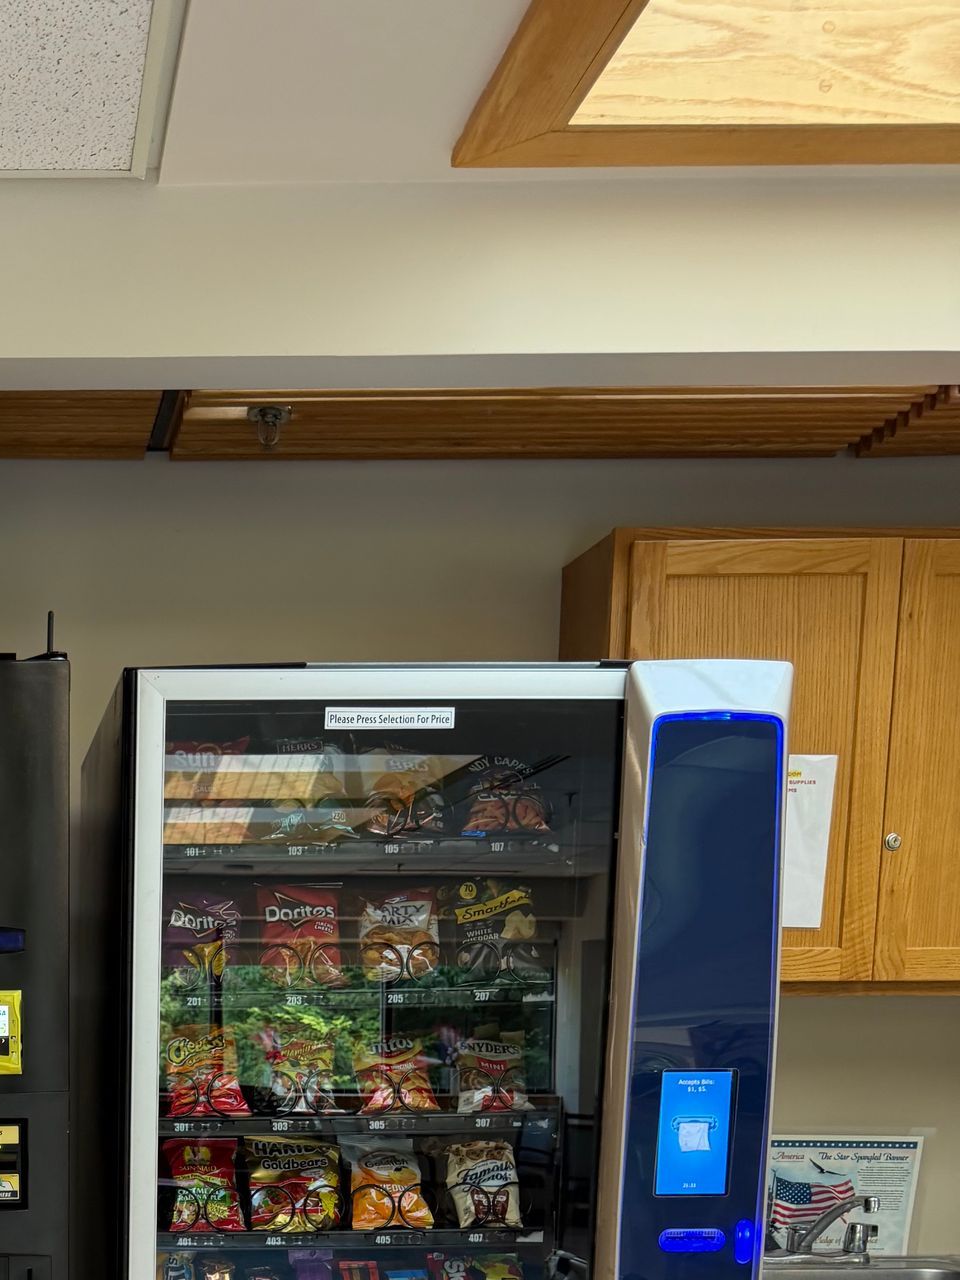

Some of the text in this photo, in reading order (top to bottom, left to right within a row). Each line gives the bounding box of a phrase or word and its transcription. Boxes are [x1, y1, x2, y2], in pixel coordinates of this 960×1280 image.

[329, 714, 450, 724] Please Press Selection For Price
[288, 846, 302, 855] 103
[384, 844, 399, 853] 105
[491, 842, 504, 851] 107
[463, 884, 473, 893] 70
[265, 906, 335, 922] Doritos
[169, 909, 237, 930] Doritos
[467, 928, 492, 938] WHITE
[286, 997, 302, 1005] 203
[388, 994, 403, 1003] 205
[475, 992, 489, 1001] 207
[187, 997, 201, 1006] 201
[459, 1041, 520, 1056] SNYDER'S
[480, 1061, 505, 1070] MINI
[678, 1078, 700, 1086] Accepts
[174, 1122, 189, 1132] 301
[272, 1122, 288, 1131] 303
[369, 1120, 385, 1130] 305
[476, 1119, 490, 1128] 307
[772, 1151, 909, 1163] America The Star Spangled Banner
[261, 1158, 328, 1171] Goldbears
[364, 1156, 409, 1169] Goldfish
[457, 1160, 515, 1184] Famous
[177, 1237, 192, 1246] 401
[265, 1236, 281, 1245] 403
[375, 1235, 391, 1244] 405
[468, 1233, 483, 1242] 407
